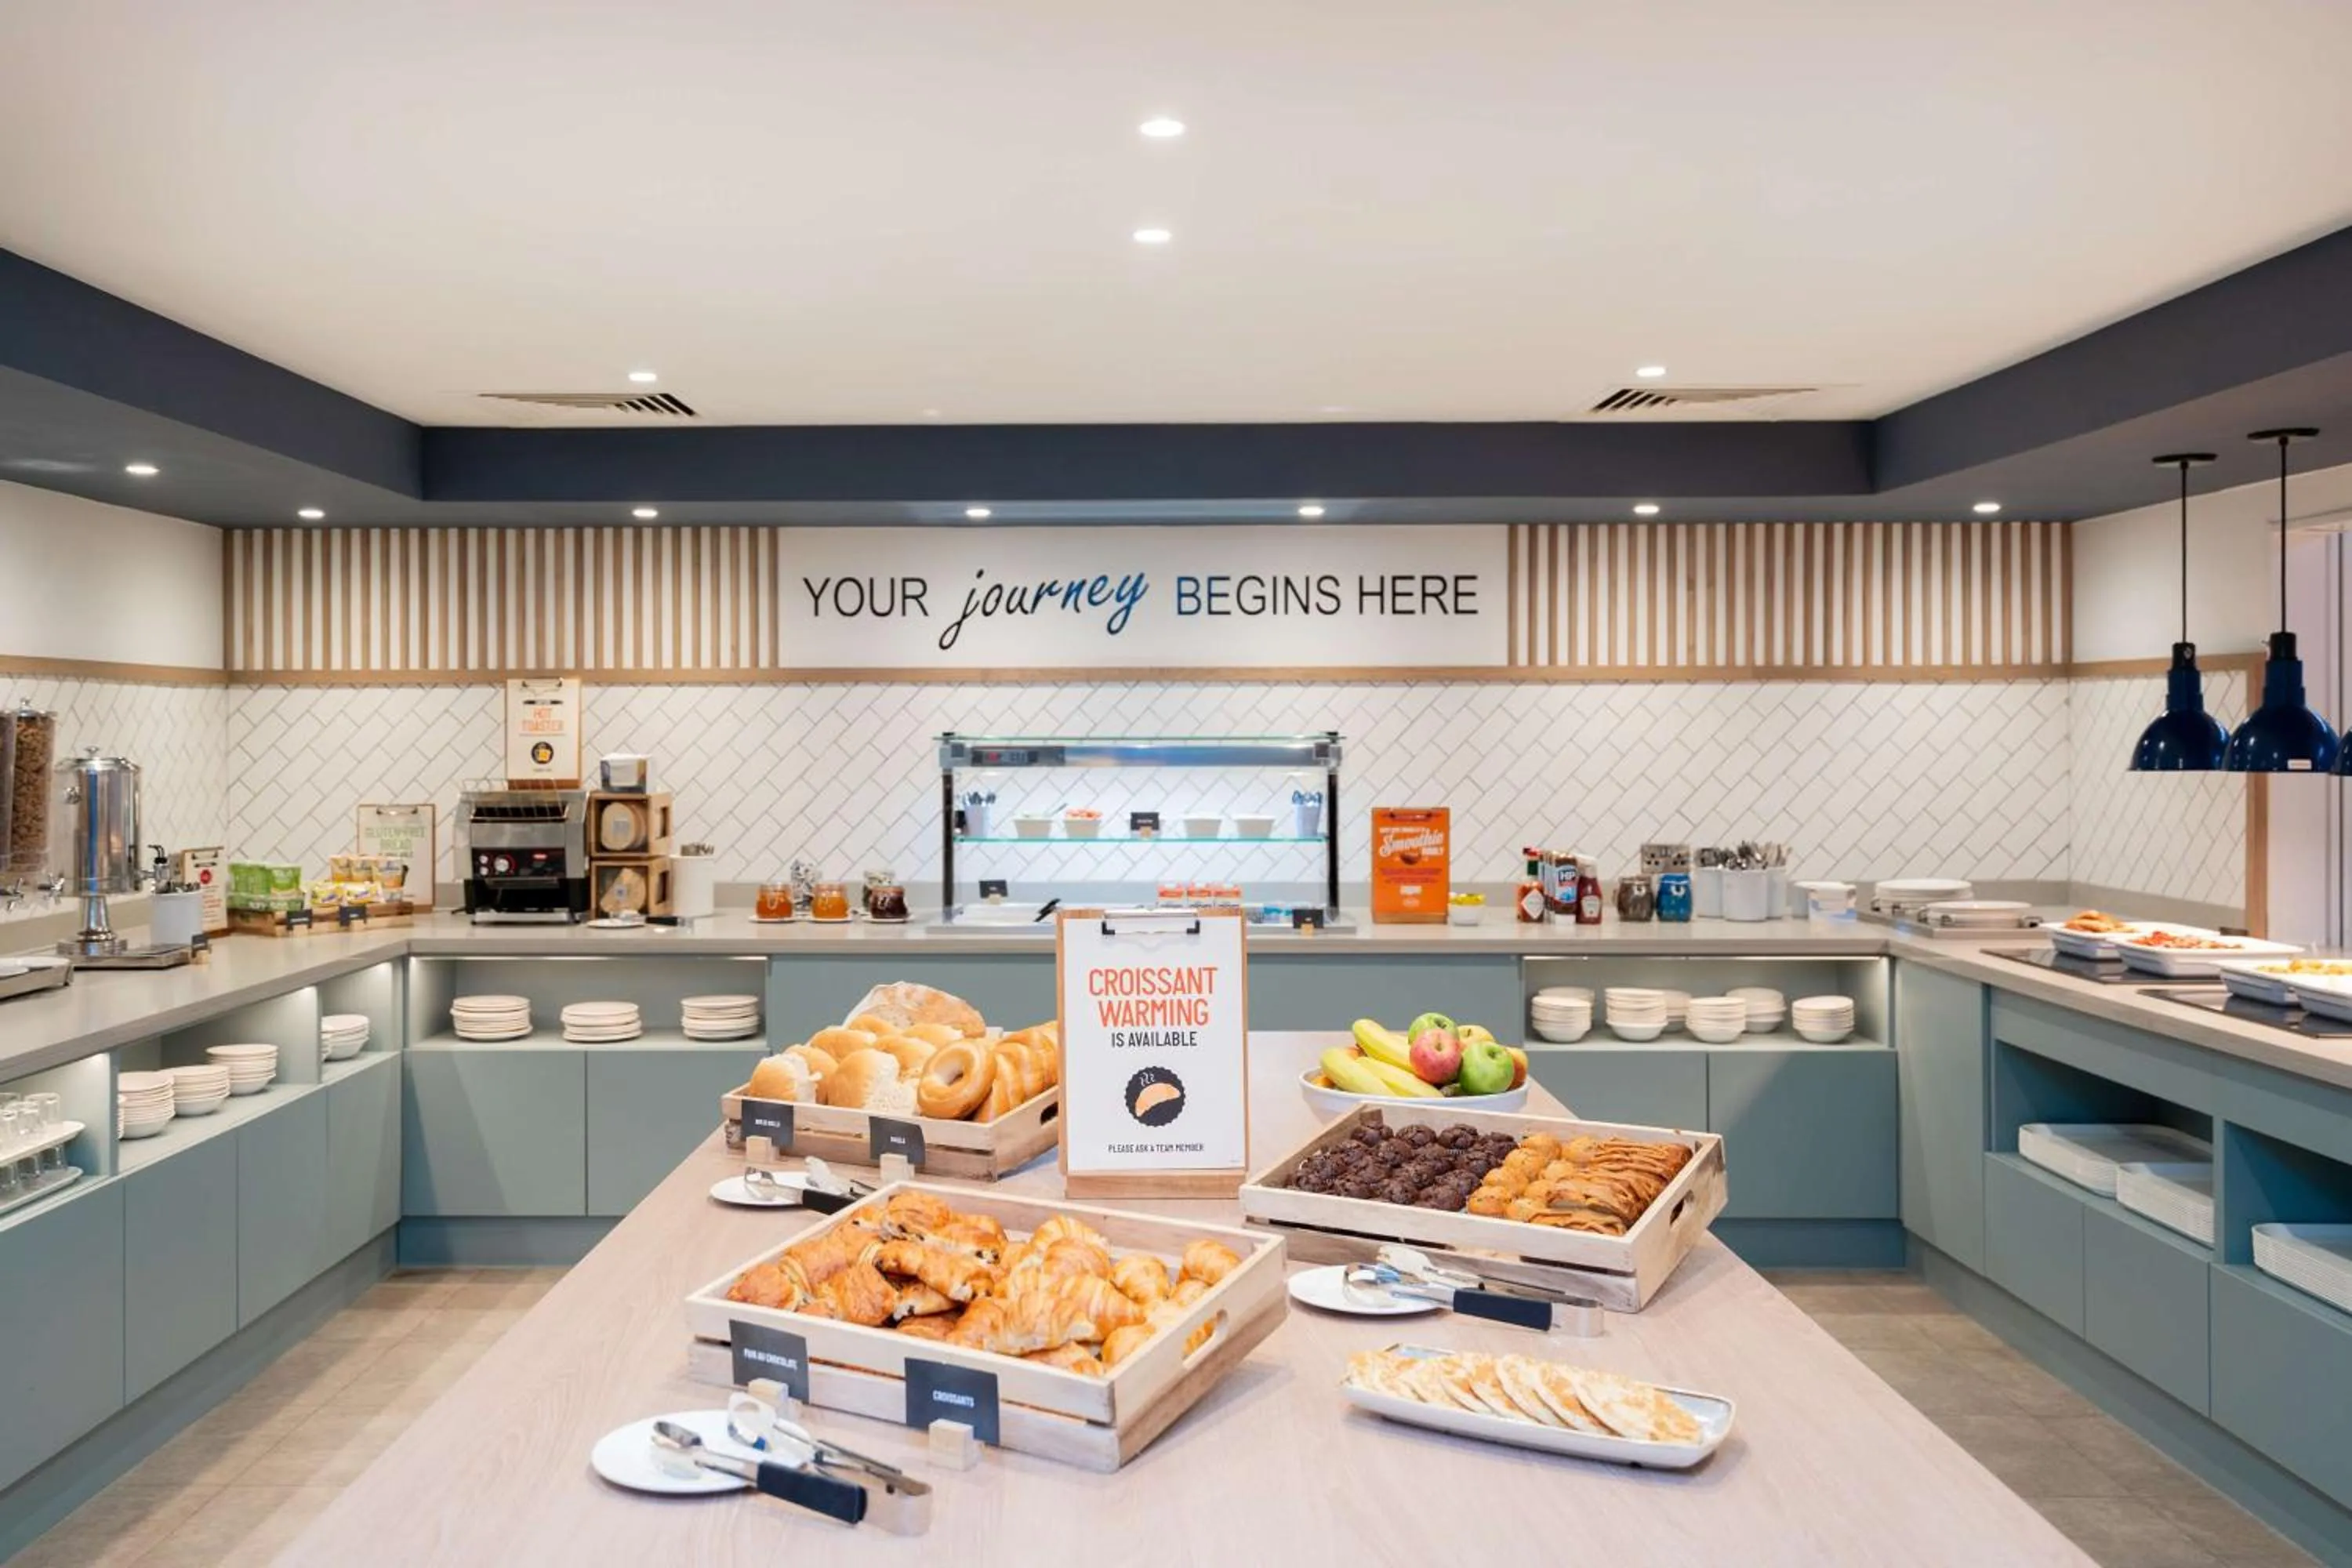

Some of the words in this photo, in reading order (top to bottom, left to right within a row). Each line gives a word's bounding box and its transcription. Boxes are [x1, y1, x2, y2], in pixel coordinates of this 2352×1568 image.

[802, 576, 930, 618] YOUR
[938, 568, 1150, 651] journey
[1176, 575, 1342, 616] BEGINS
[1358, 575, 1479, 615] HERE
[1559, 870, 1575, 881] HP
[1089, 967, 1218, 996] CROISSANT
[1098, 998, 1209, 1028] WARMING
[1111, 1032, 1125, 1048] IS
[1127, 1031, 1198, 1047] AVAILABLE
[1108, 1144, 1134, 1153] PLEASE
[1134, 1144, 1149, 1152] ASK
[1156, 1144, 1174, 1152] TEAM
[1175, 1143, 1204, 1152] MEMBER
